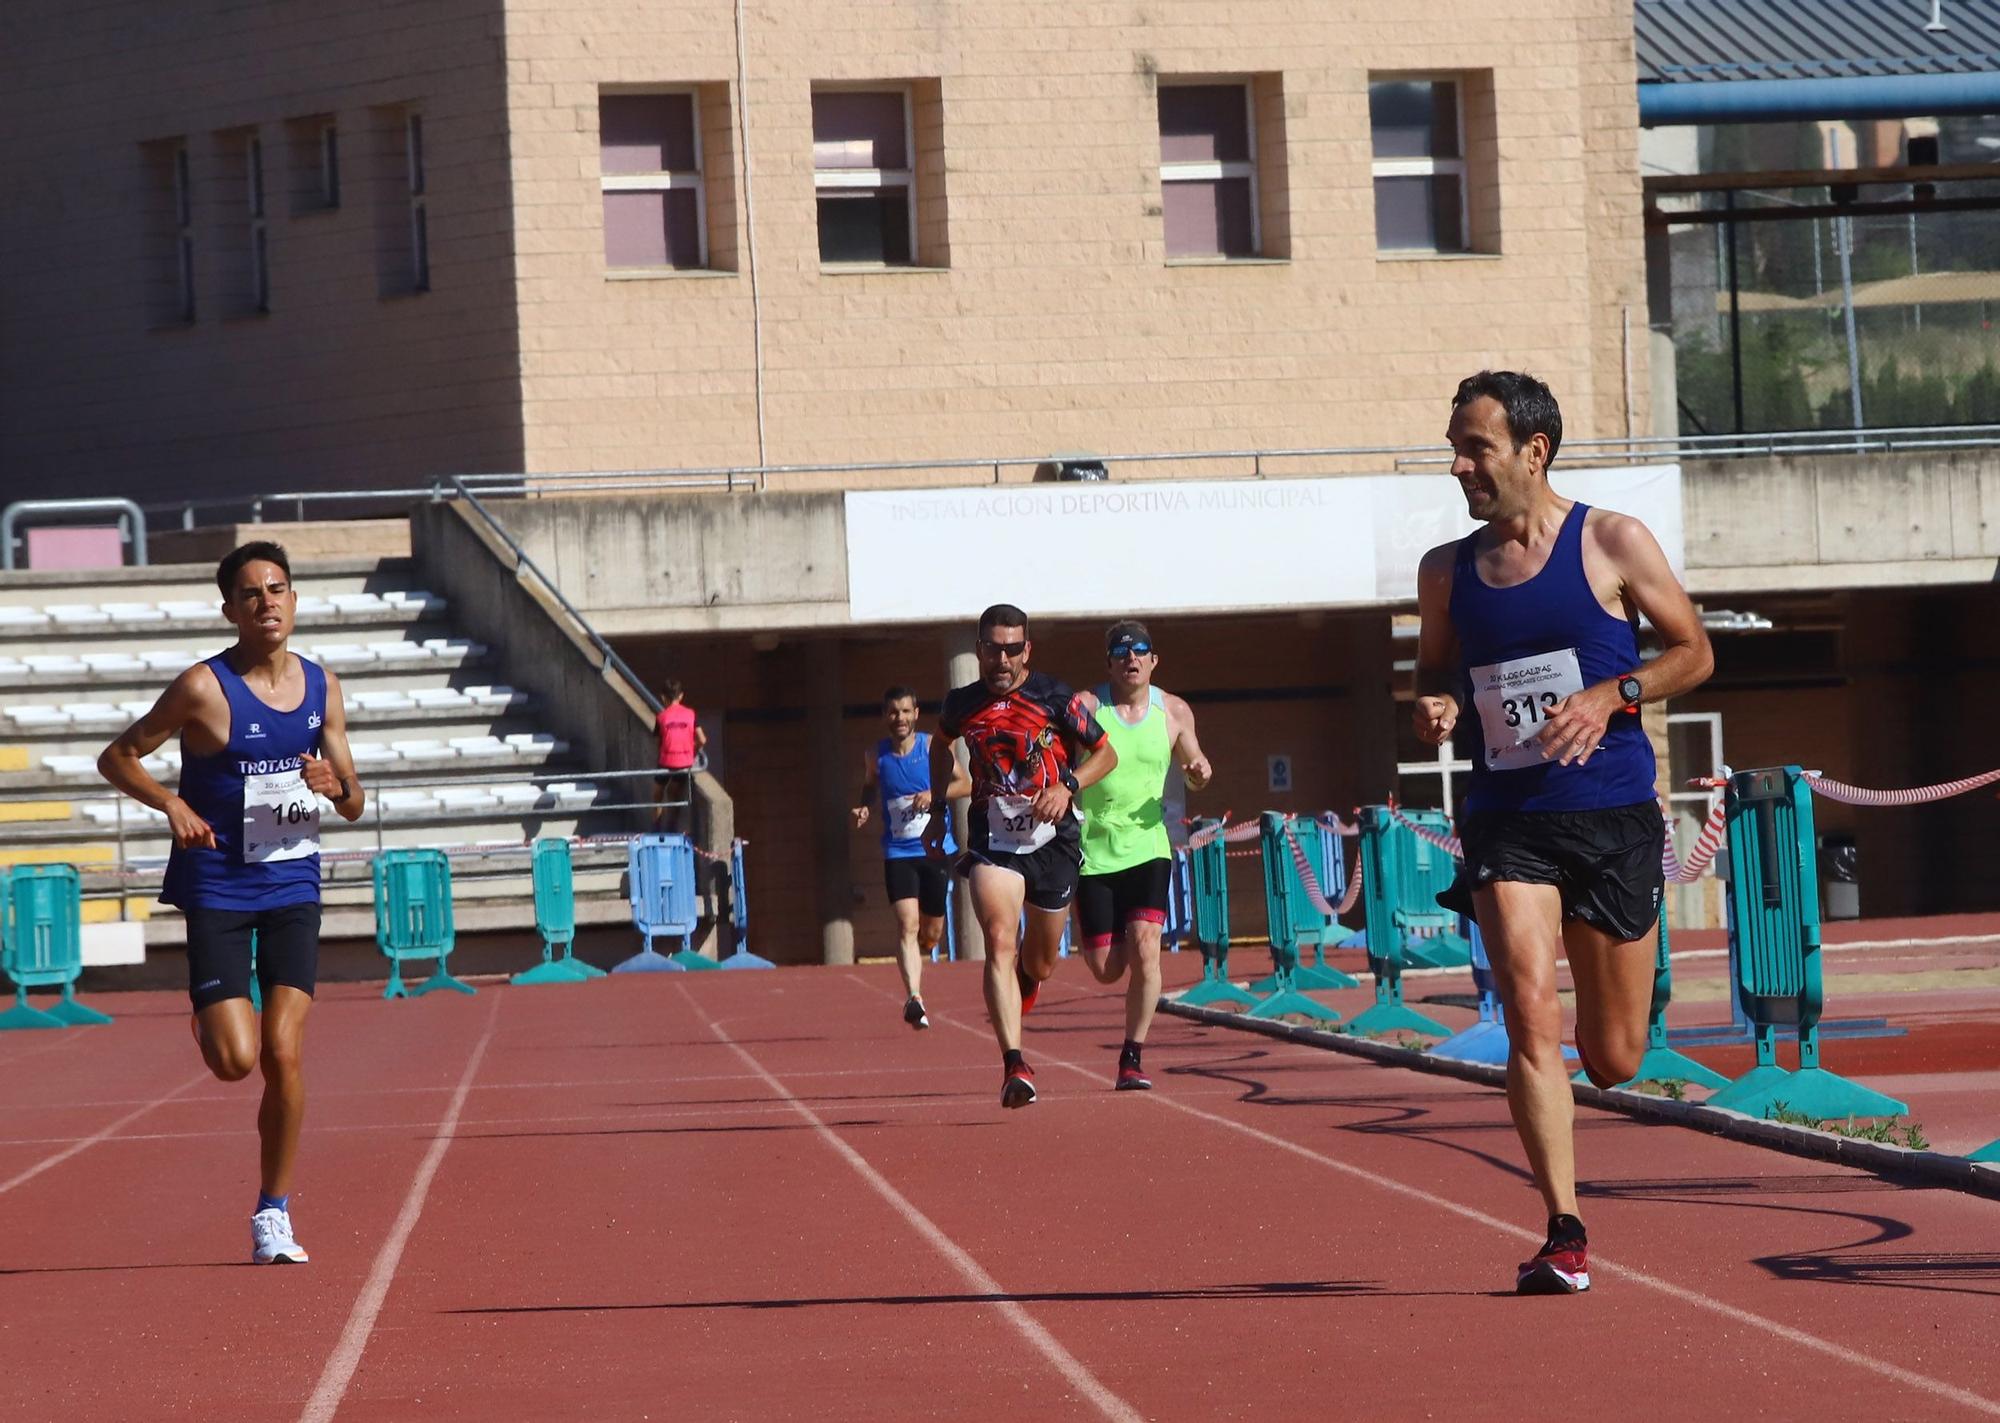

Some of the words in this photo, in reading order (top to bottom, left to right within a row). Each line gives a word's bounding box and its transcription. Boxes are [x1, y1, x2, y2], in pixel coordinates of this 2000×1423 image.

[1062, 490, 1190, 516] DEPORTIVA
[1199, 486, 1329, 511] MUNICIPAL
[239, 757, 304, 774] TROTASIE
[272, 799, 310, 826] 106
[1003, 814, 1034, 832] 327
